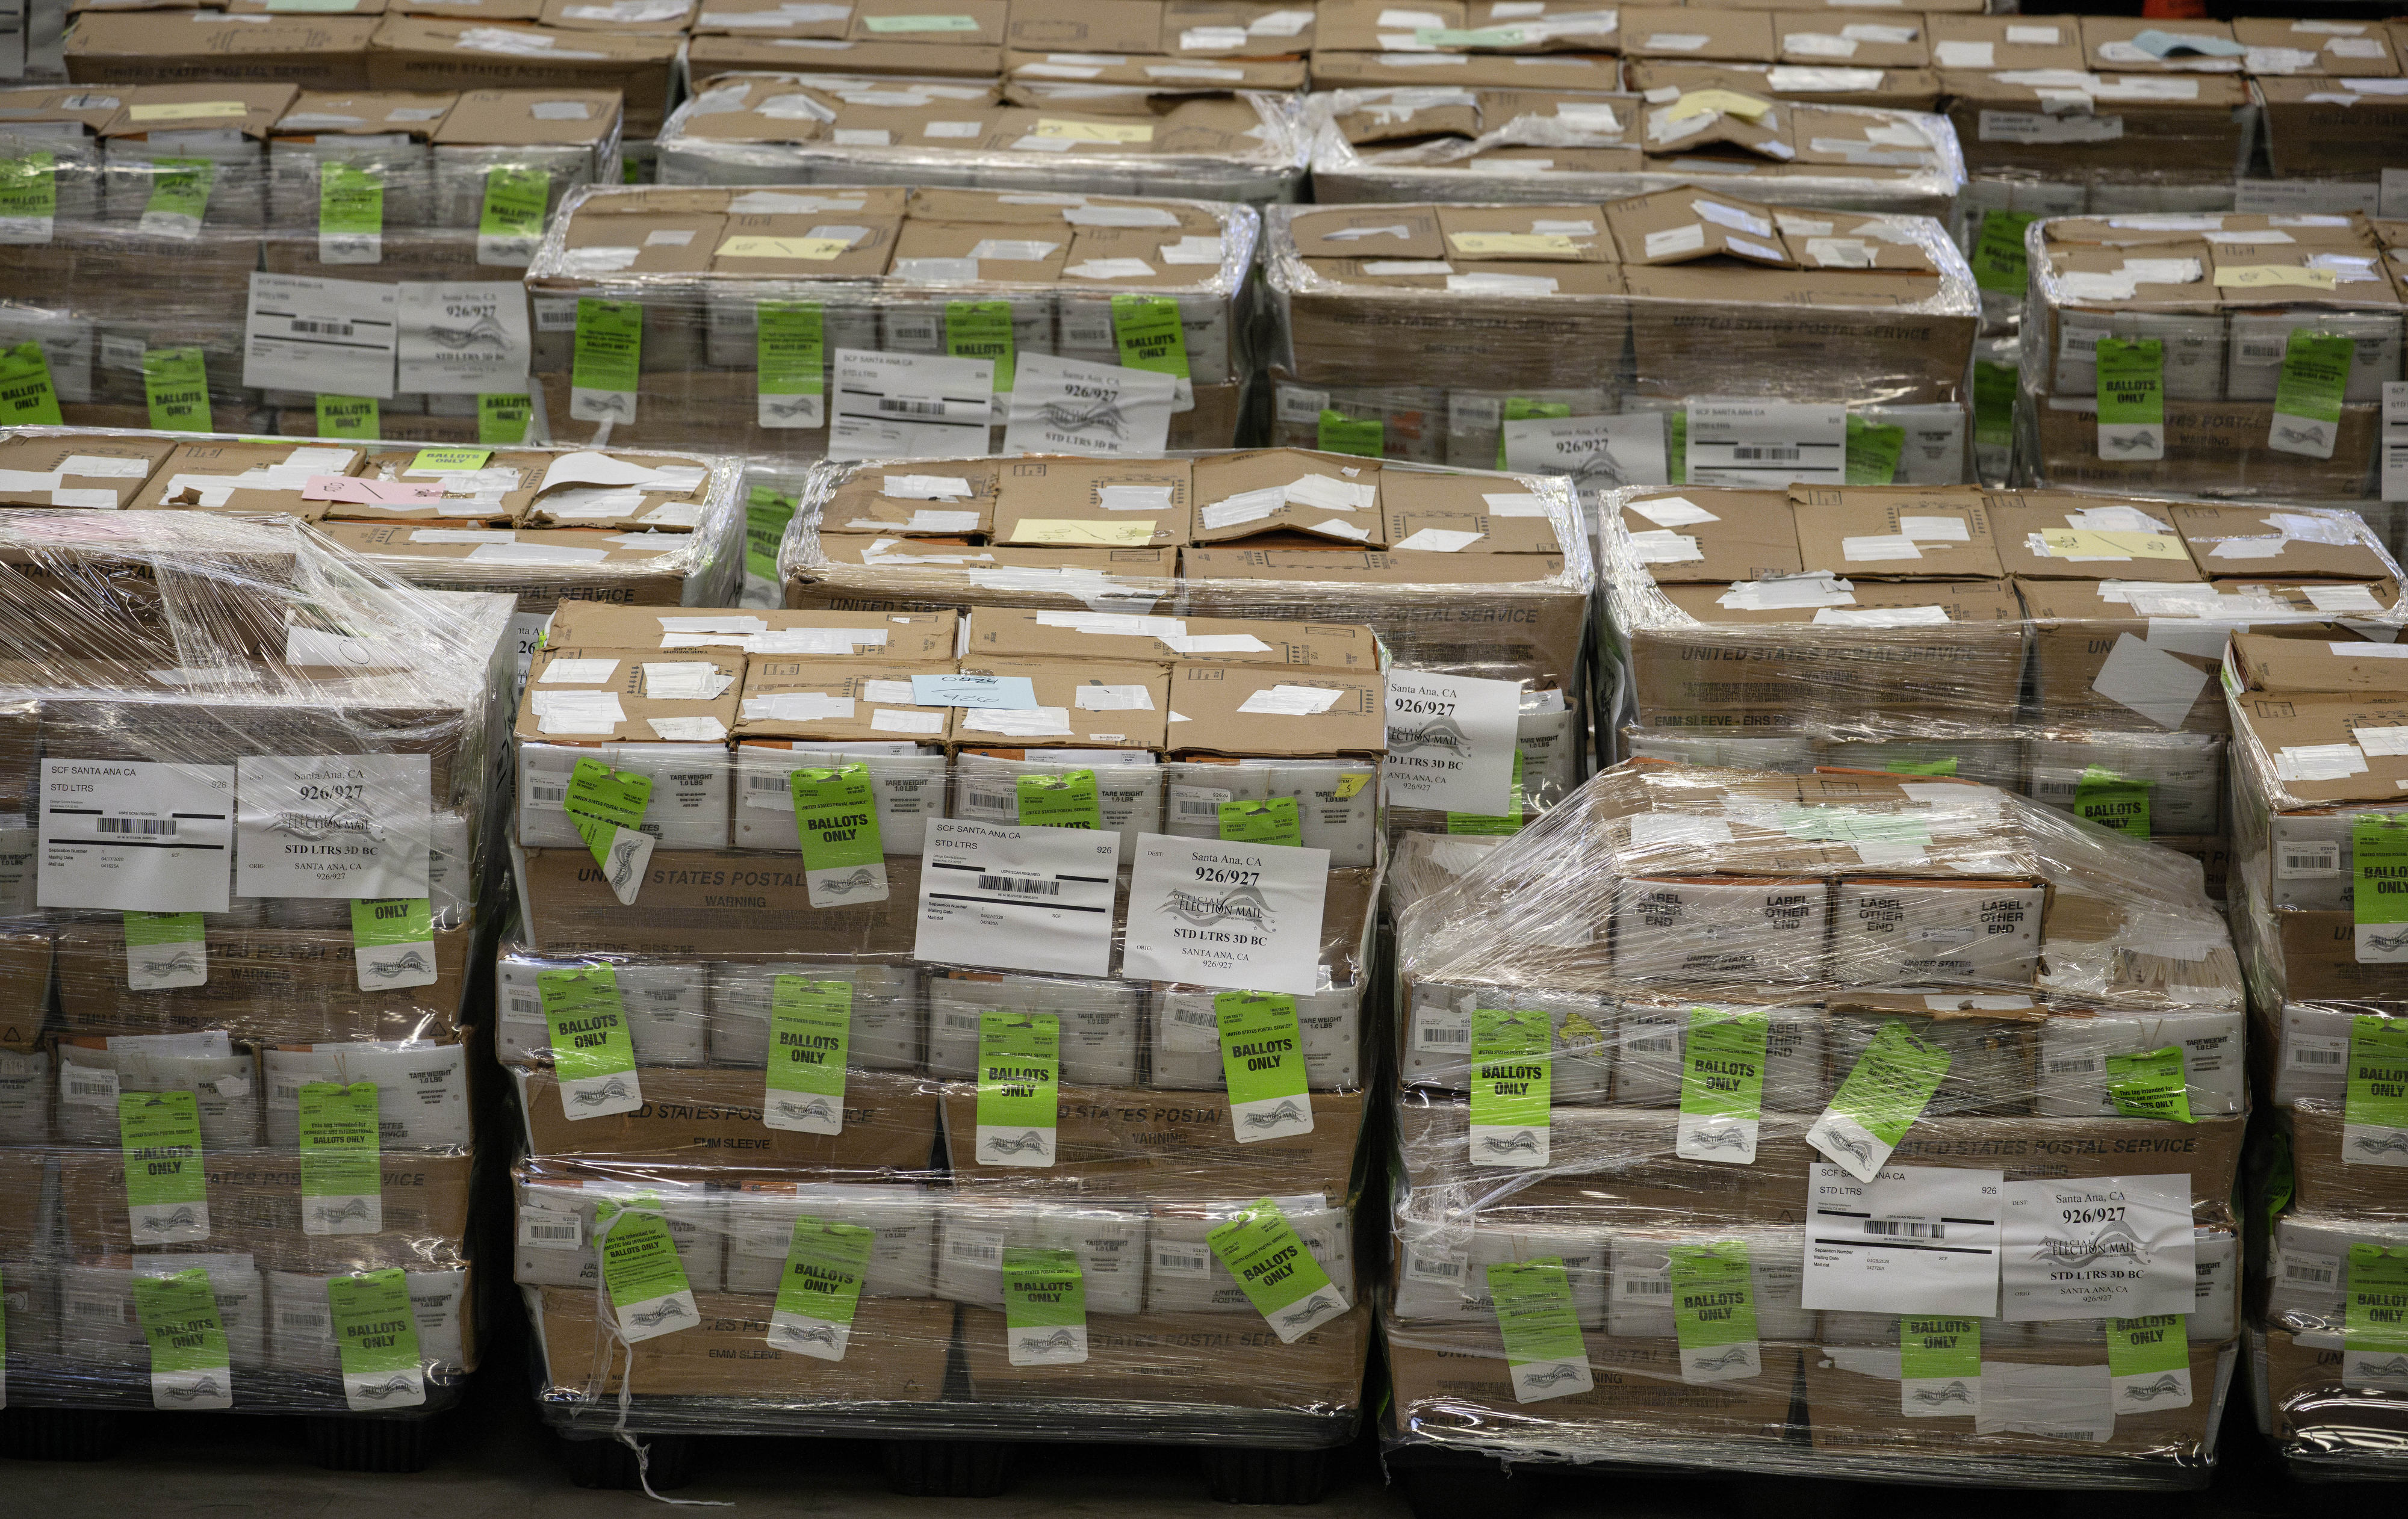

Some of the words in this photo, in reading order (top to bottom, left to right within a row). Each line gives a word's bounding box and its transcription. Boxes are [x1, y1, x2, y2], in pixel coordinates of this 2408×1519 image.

[447, 305, 495, 317] 926/927
[1126, 334, 1176, 350] BALLOTS
[1140, 346, 1167, 360] ONLY
[1, 383, 48, 400] BALLOTS
[1064, 384, 1117, 402] 926/927
[2107, 380, 2155, 392] BALLOTS
[14, 397, 40, 410] ONLY
[2117, 392, 2144, 404] ONLY
[1556, 438, 1609, 453] 926/927
[1459, 609, 1537, 623] SERVICE
[1391, 683, 1415, 694] Santa
[1419, 687, 1439, 696] Ana,
[1442, 688, 1457, 698] CA
[1395, 698, 1456, 716] 926/927
[1433, 735, 1459, 745] MAIL
[1400, 757, 1429, 767] LTRS
[1431, 759, 1445, 768] 3D
[1448, 761, 1463, 770] BC
[72, 767, 101, 775] SANTA
[349, 770, 363, 779] CA
[300, 785, 363, 800] 926/927
[1403, 783, 1430, 791] 926/927
[2085, 802, 2141, 818] BALLOTS
[808, 814, 867, 830] BALLOTS
[823, 829, 856, 843] ONLY
[957, 826, 986, 835] SANTA
[988, 830, 1006, 838] ANA
[285, 845, 308, 853] STD
[312, 846, 341, 854] LTRS
[1192, 852, 1217, 863] Santa
[1221, 855, 1243, 865] Ana,
[1246, 857, 1262, 866] CA
[1196, 867, 1259, 886] 926/927
[1174, 894, 1220, 903] OFFICIAL
[1981, 900, 2023, 911] LABEL
[375, 905, 408, 919] ONLY
[1179, 901, 1233, 915] ELECTION
[1235, 908, 1262, 918] MAIL
[1981, 912, 2023, 923] OTHER
[1988, 923, 2015, 933] END
[1174, 928, 1197, 939] STD
[1200, 931, 1230, 942] LTRS
[1233, 934, 1247, 944] 3D
[1251, 936, 1267, 946] BC
[1182, 947, 1211, 957] SANTA
[1214, 951, 1235, 960] ANA,
[1203, 961, 1232, 970] 926/927
[559, 1015, 618, 1035] BALLOTS
[574, 1031, 607, 1048] ONLY
[780, 1032, 839, 1050] BALLOTS
[1232, 1039, 1292, 1057] BALLOTS
[791, 1049, 824, 1064] ONLY
[1247, 1055, 1280, 1071] ONLY
[989, 1067, 1048, 1081] BALLOTS
[1482, 1066, 1542, 1079] BALLOTS
[1695, 1059, 1755, 1077] BALLOTS
[1001, 1083, 1035, 1097] ONLY
[1495, 1083, 1528, 1095] ONLY
[1706, 1076, 1741, 1091] ONLY
[694, 1137, 721, 1148] EMM
[724, 1138, 770, 1149] SLEEVE
[2114, 1138, 2195, 1152] SERVICE
[133, 1145, 193, 1162] BALLOTS
[147, 1162, 181, 1176] ONLY
[2056, 1195, 2082, 1203] Santa
[2085, 1194, 2106, 1202] Ana,
[2109, 1192, 2125, 1201] CA
[2062, 1207, 2125, 1224] 926/927
[610, 1246, 640, 1258] BALLOTS
[642, 1242, 659, 1251] ONLY
[2053, 1245, 2105, 1255] ELECTION
[2109, 1243, 2136, 1253] MAIL
[1243, 1245, 1298, 1281] BALLOTS
[795, 1263, 854, 1283] BALLOTS
[1263, 1263, 1294, 1286] ONLY
[2078, 1271, 2106, 1279] LTRS
[2129, 1270, 2144, 1278] BC
[804, 1279, 837, 1295] ONLY
[1014, 1282, 1073, 1292] BALLOTS
[1028, 1293, 1061, 1303] ONLY
[1684, 1292, 1743, 1308] BALLOTS
[1699, 1307, 1733, 1320] ONLY
[2370, 1309, 2404, 1323] ONLY
[347, 1320, 406, 1338] BALLOTS
[1911, 1321, 1970, 1334] BALLOTS
[2115, 1315, 2176, 1331] BALLOTS
[362, 1335, 396, 1349] ONLY
[1923, 1335, 1958, 1349] ONLY
[2130, 1329, 2164, 1346] ONLY
